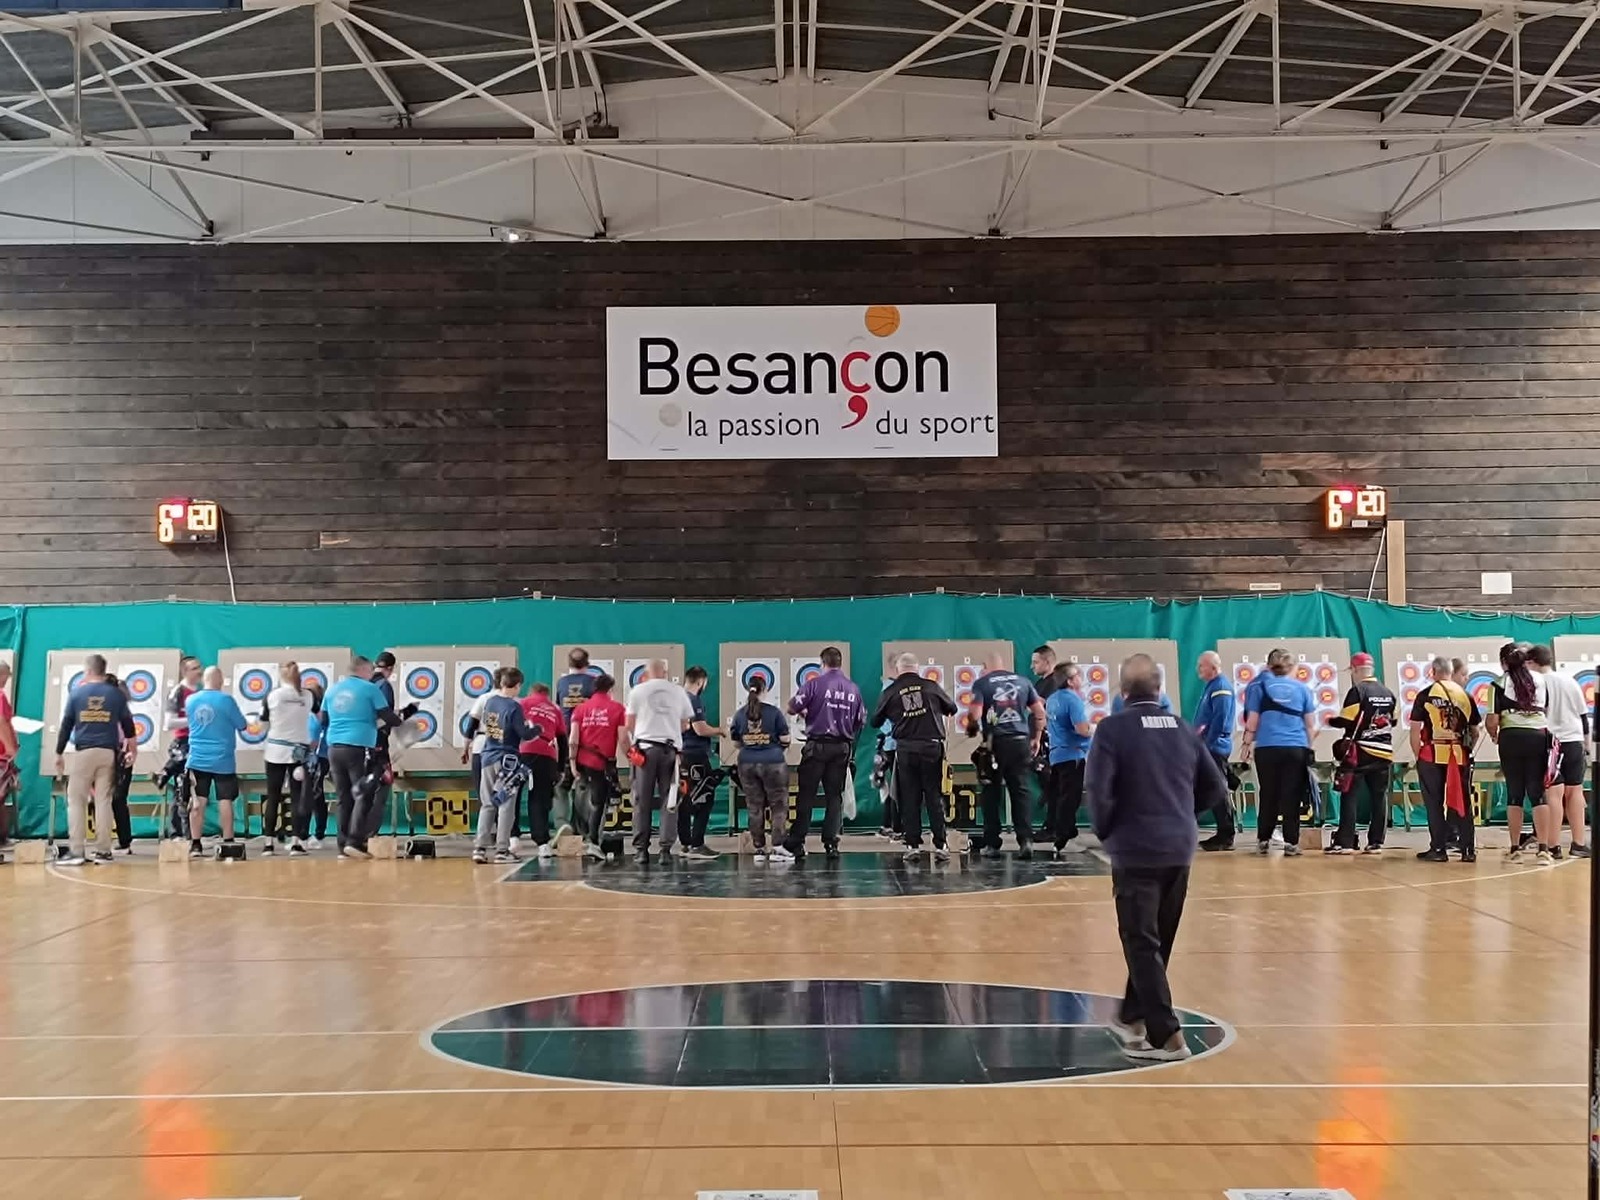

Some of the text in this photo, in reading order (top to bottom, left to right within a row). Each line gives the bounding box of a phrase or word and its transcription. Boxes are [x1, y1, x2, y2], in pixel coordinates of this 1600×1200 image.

[638, 336, 950, 429] Besançon
[687, 410, 995, 444] la passion du sport
[428, 797, 467, 829] 04
